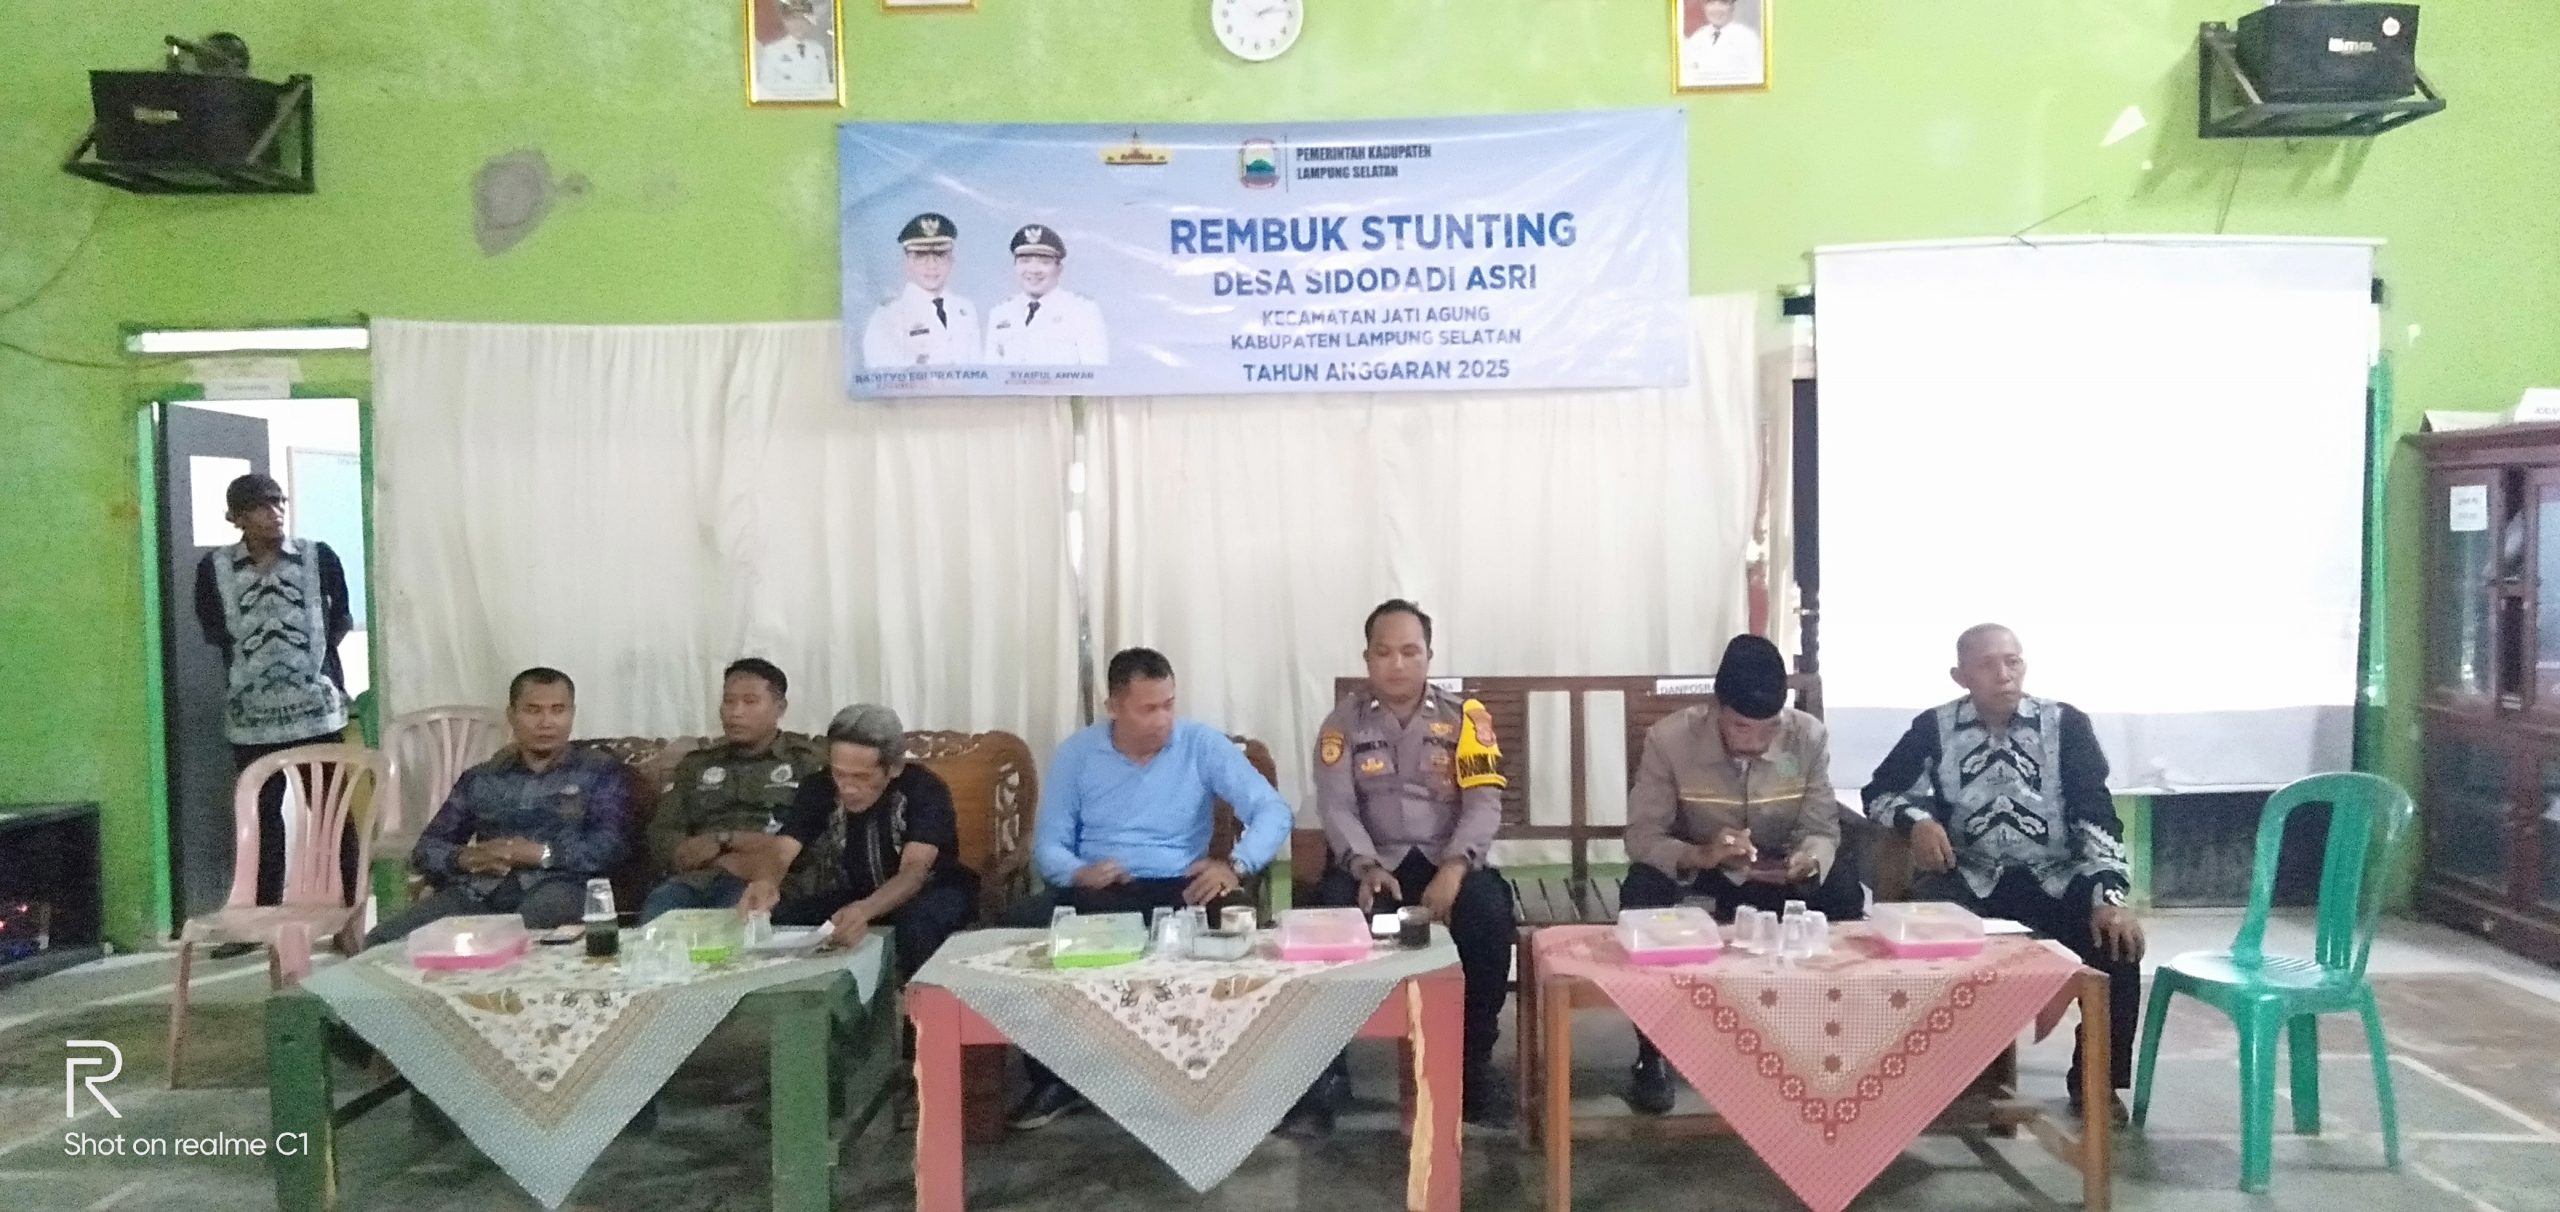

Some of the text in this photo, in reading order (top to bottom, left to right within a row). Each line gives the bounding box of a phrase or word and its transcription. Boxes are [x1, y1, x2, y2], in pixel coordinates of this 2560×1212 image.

[1296, 144, 1432, 162] PEMERINTAH KABUPATEN
[1297, 165, 1398, 180] LAMPUNG SELATAN
[1170, 211, 1577, 254] REMBUK STUNTING
[1213, 264, 1537, 296] DESA SIDODADI ASRI
[1262, 306, 1490, 327] KECAMATAN JATI AGUNG
[1231, 329, 1521, 350] KABUPATEN LAMPUNG SELATAN
[1055, 370, 1094, 380] ANWAR
[1243, 359, 1510, 382] TAHUN ANGGARAN 2025
